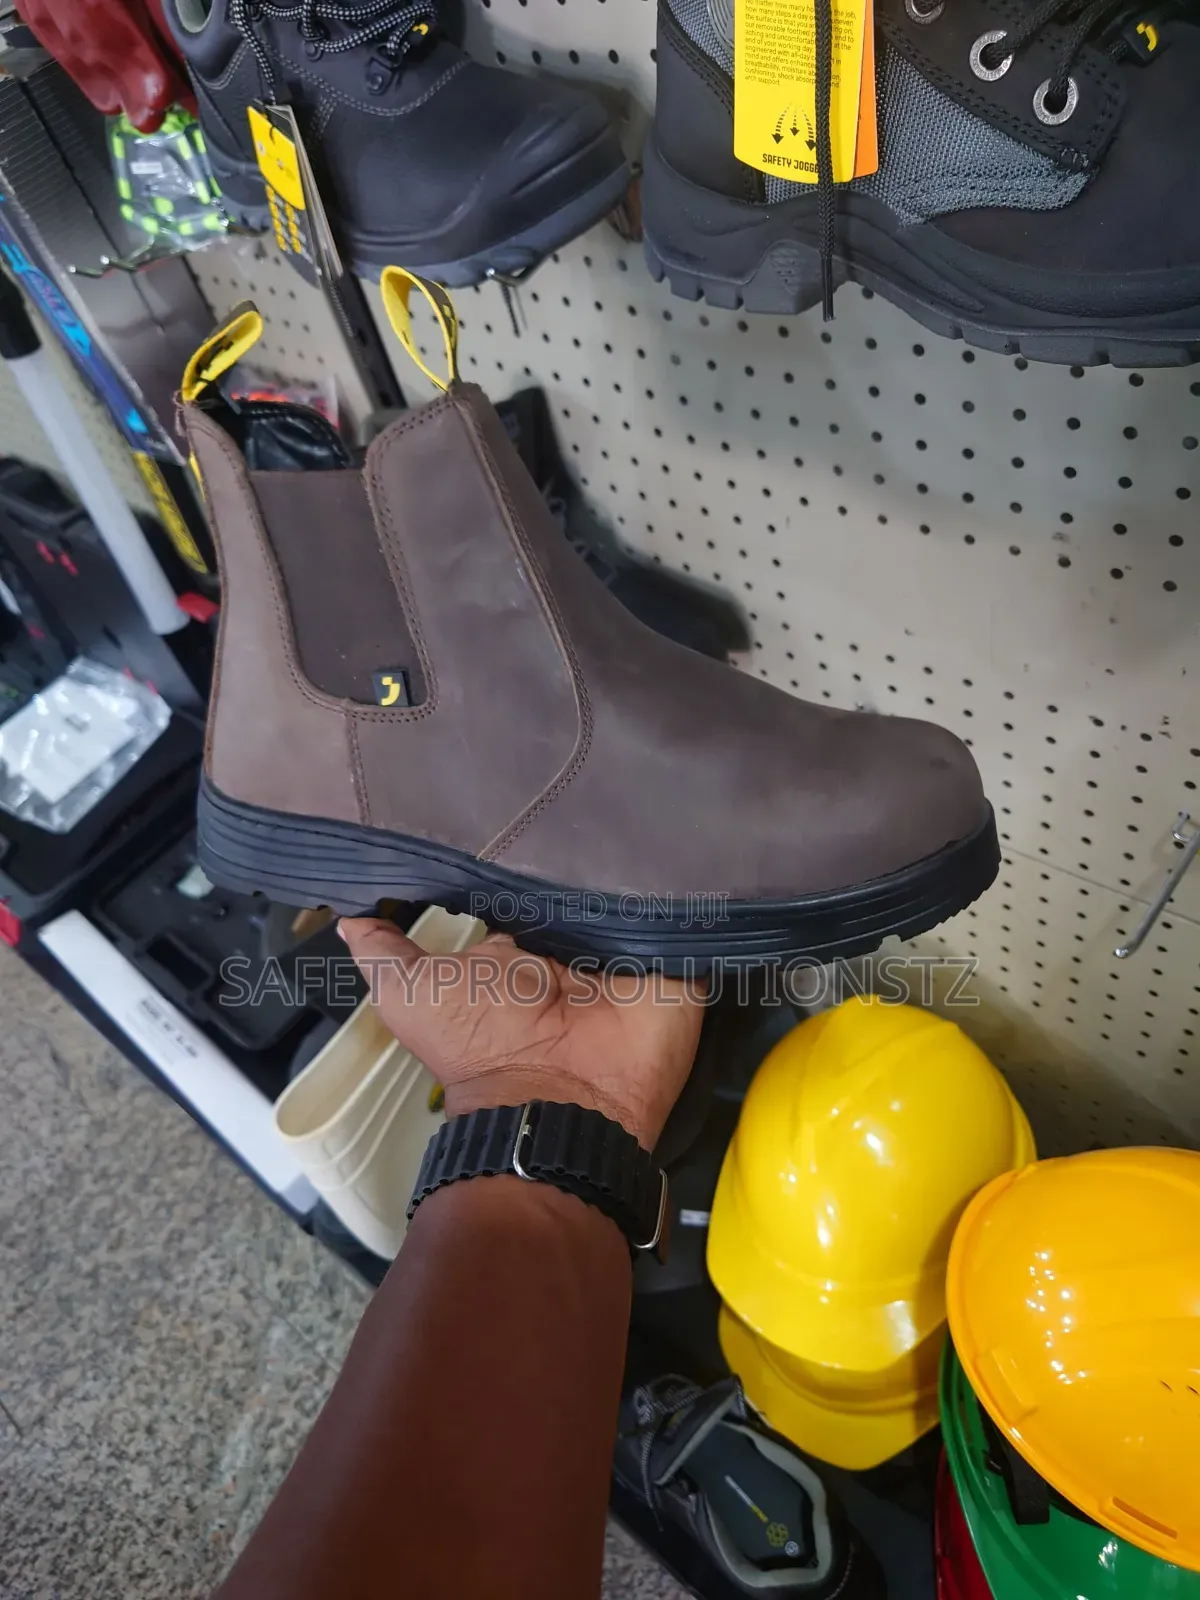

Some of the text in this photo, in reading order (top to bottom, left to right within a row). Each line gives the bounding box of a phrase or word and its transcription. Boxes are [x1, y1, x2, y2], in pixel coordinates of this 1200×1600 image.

[759, 8, 775, 16] many
[776, 10, 791, 18] steps
[789, 4, 806, 12] many
[834, 9, 844, 17] the
[756, 15, 777, 23] surface
[756, 23, 786, 33] removable
[787, 26, 810, 35] footbed
[745, 30, 764, 38] aching
[777, 34, 814, 45] uncomfortab
[841, 43, 852, 51] the
[745, 45, 777, 55] engineered
[778, 42, 801, 52] working
[772, 56, 788, 64] offers
[790, 60, 815, 68] enhance
[782, 66, 807, 75] moisture
[758, 77, 780, 85] support
[778, 72, 795, 81] shock
[762, 153, 819, 174] SAFETY JOGGE
